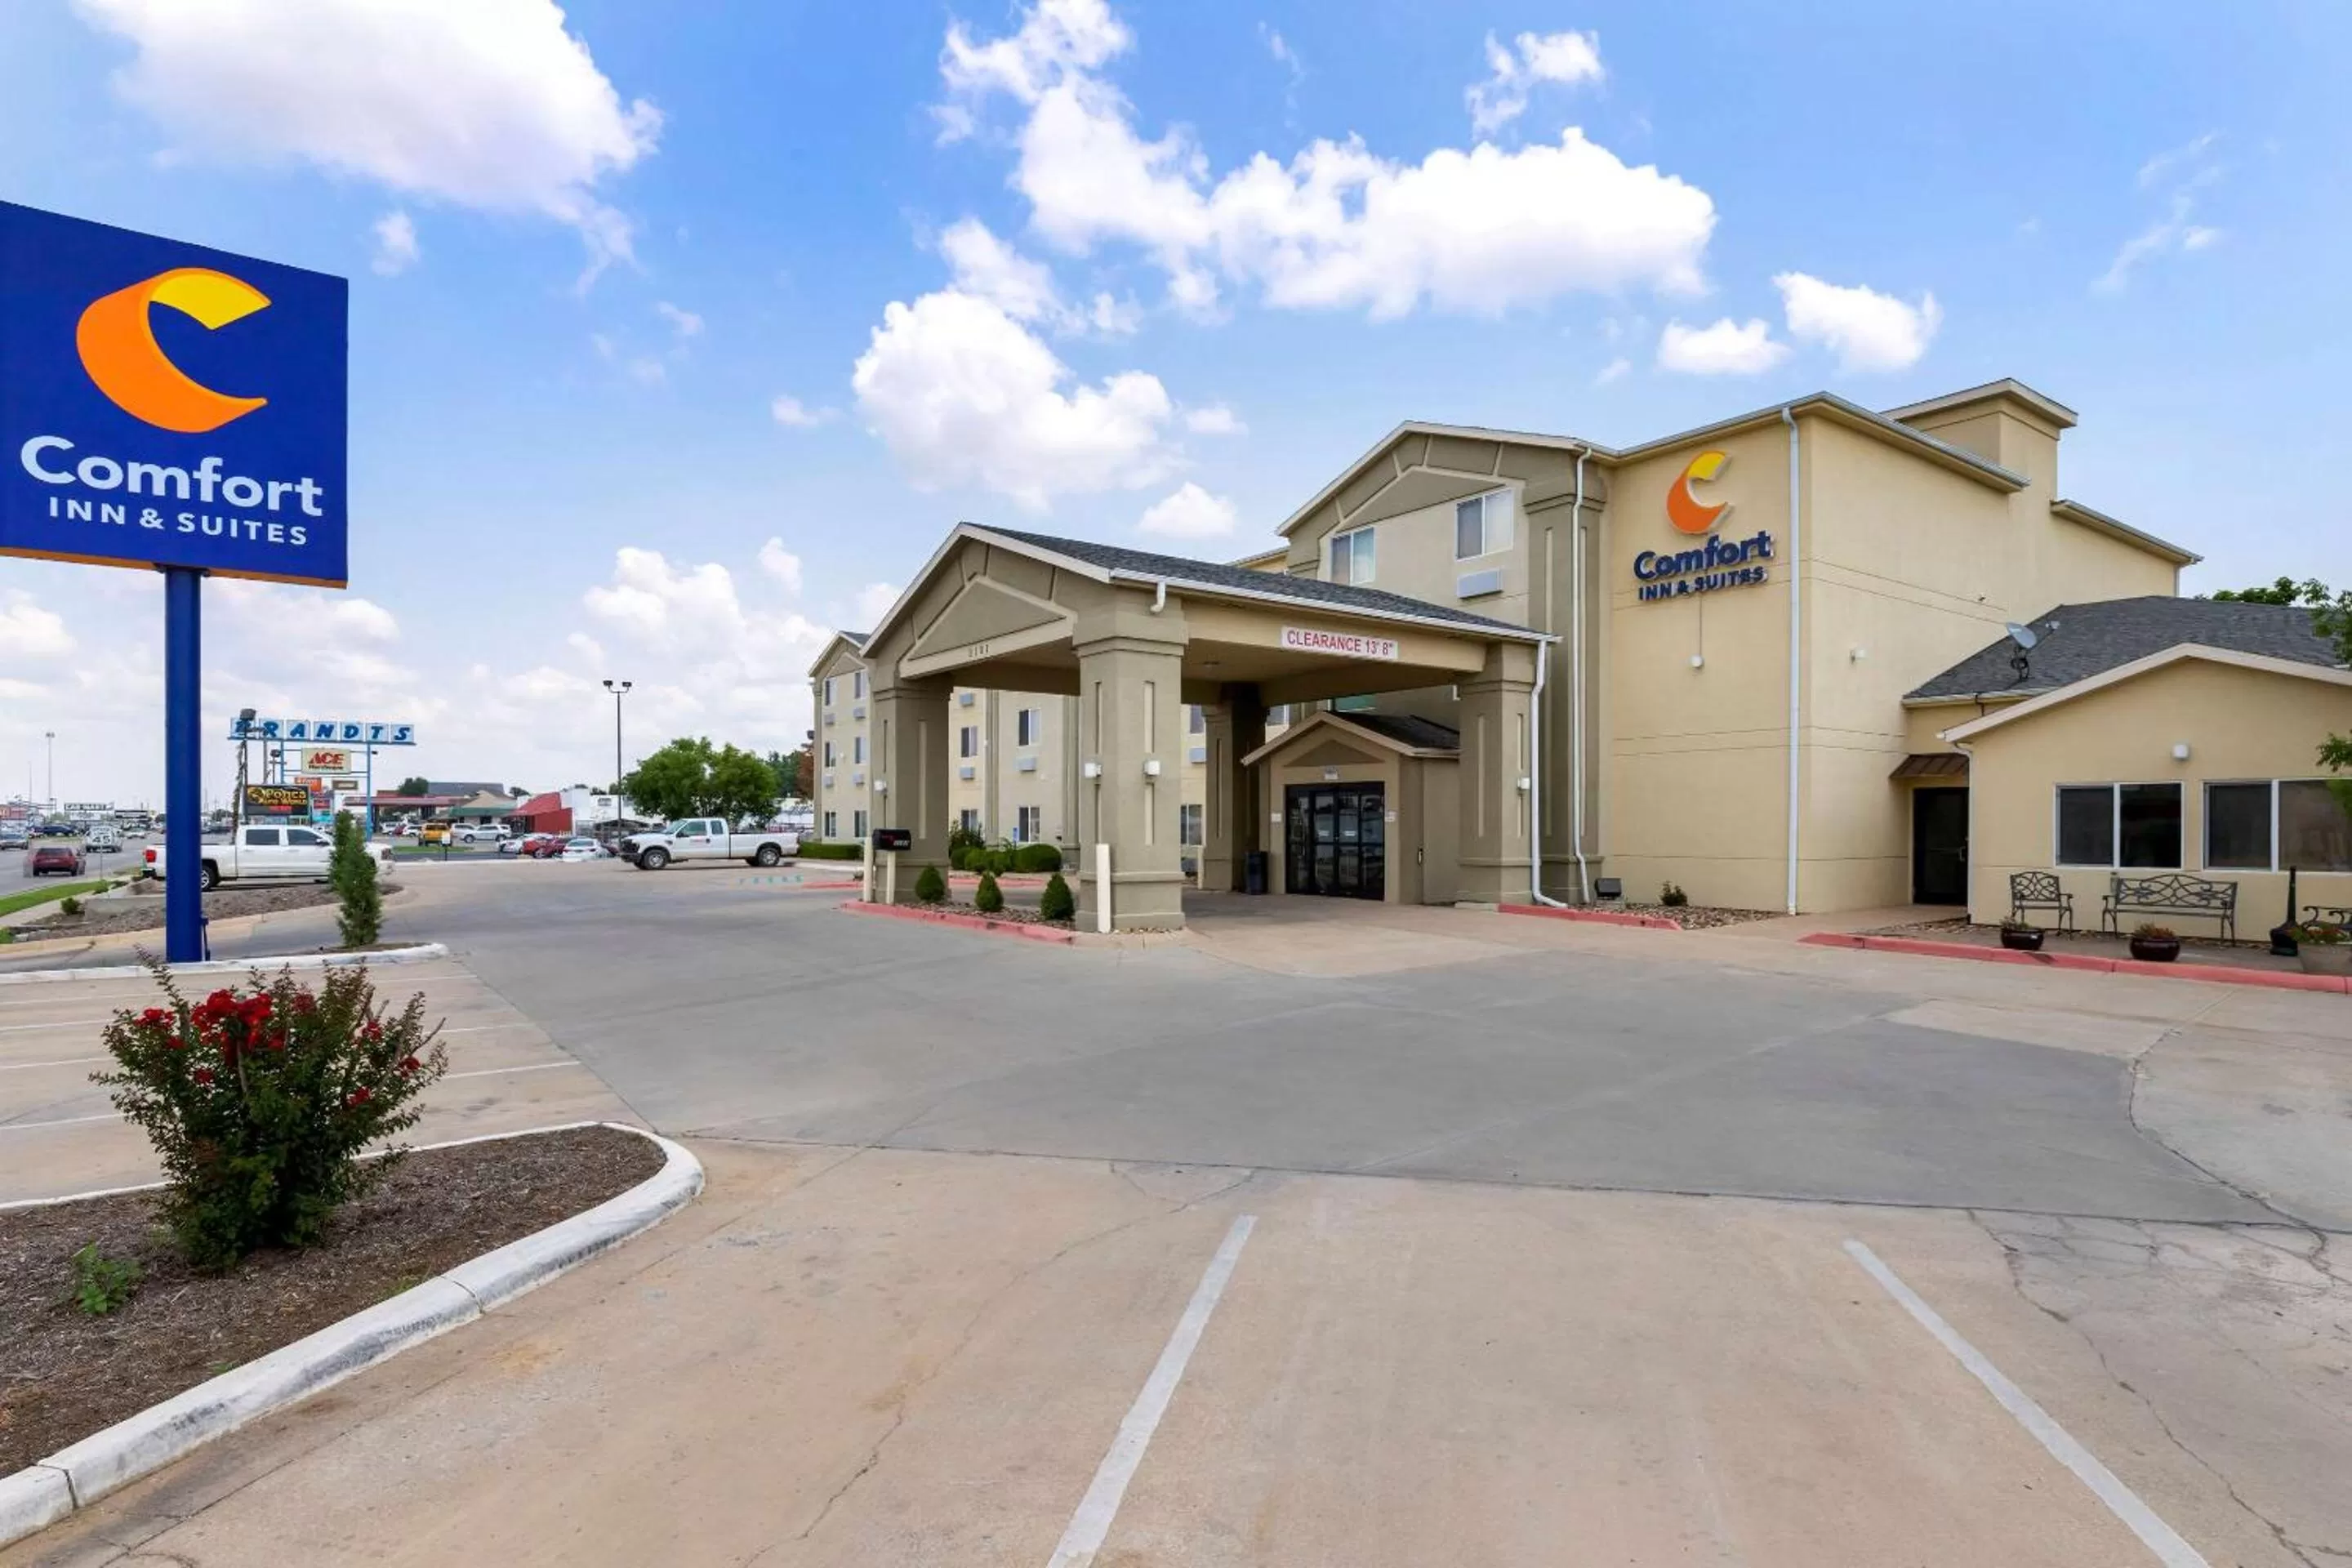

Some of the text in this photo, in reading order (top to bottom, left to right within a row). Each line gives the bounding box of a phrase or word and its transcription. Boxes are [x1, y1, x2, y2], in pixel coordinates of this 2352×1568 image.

[20, 435, 323, 517] Comfort
[49, 497, 308, 546] INN & SUITES
[1634, 530, 1774, 581] Comfort
[1638, 566, 1767, 601] INN & SUITES
[1287, 630, 1361, 653] CLEARANCE
[308, 752, 345, 764] ACE
[92, 835, 111, 844] 45
